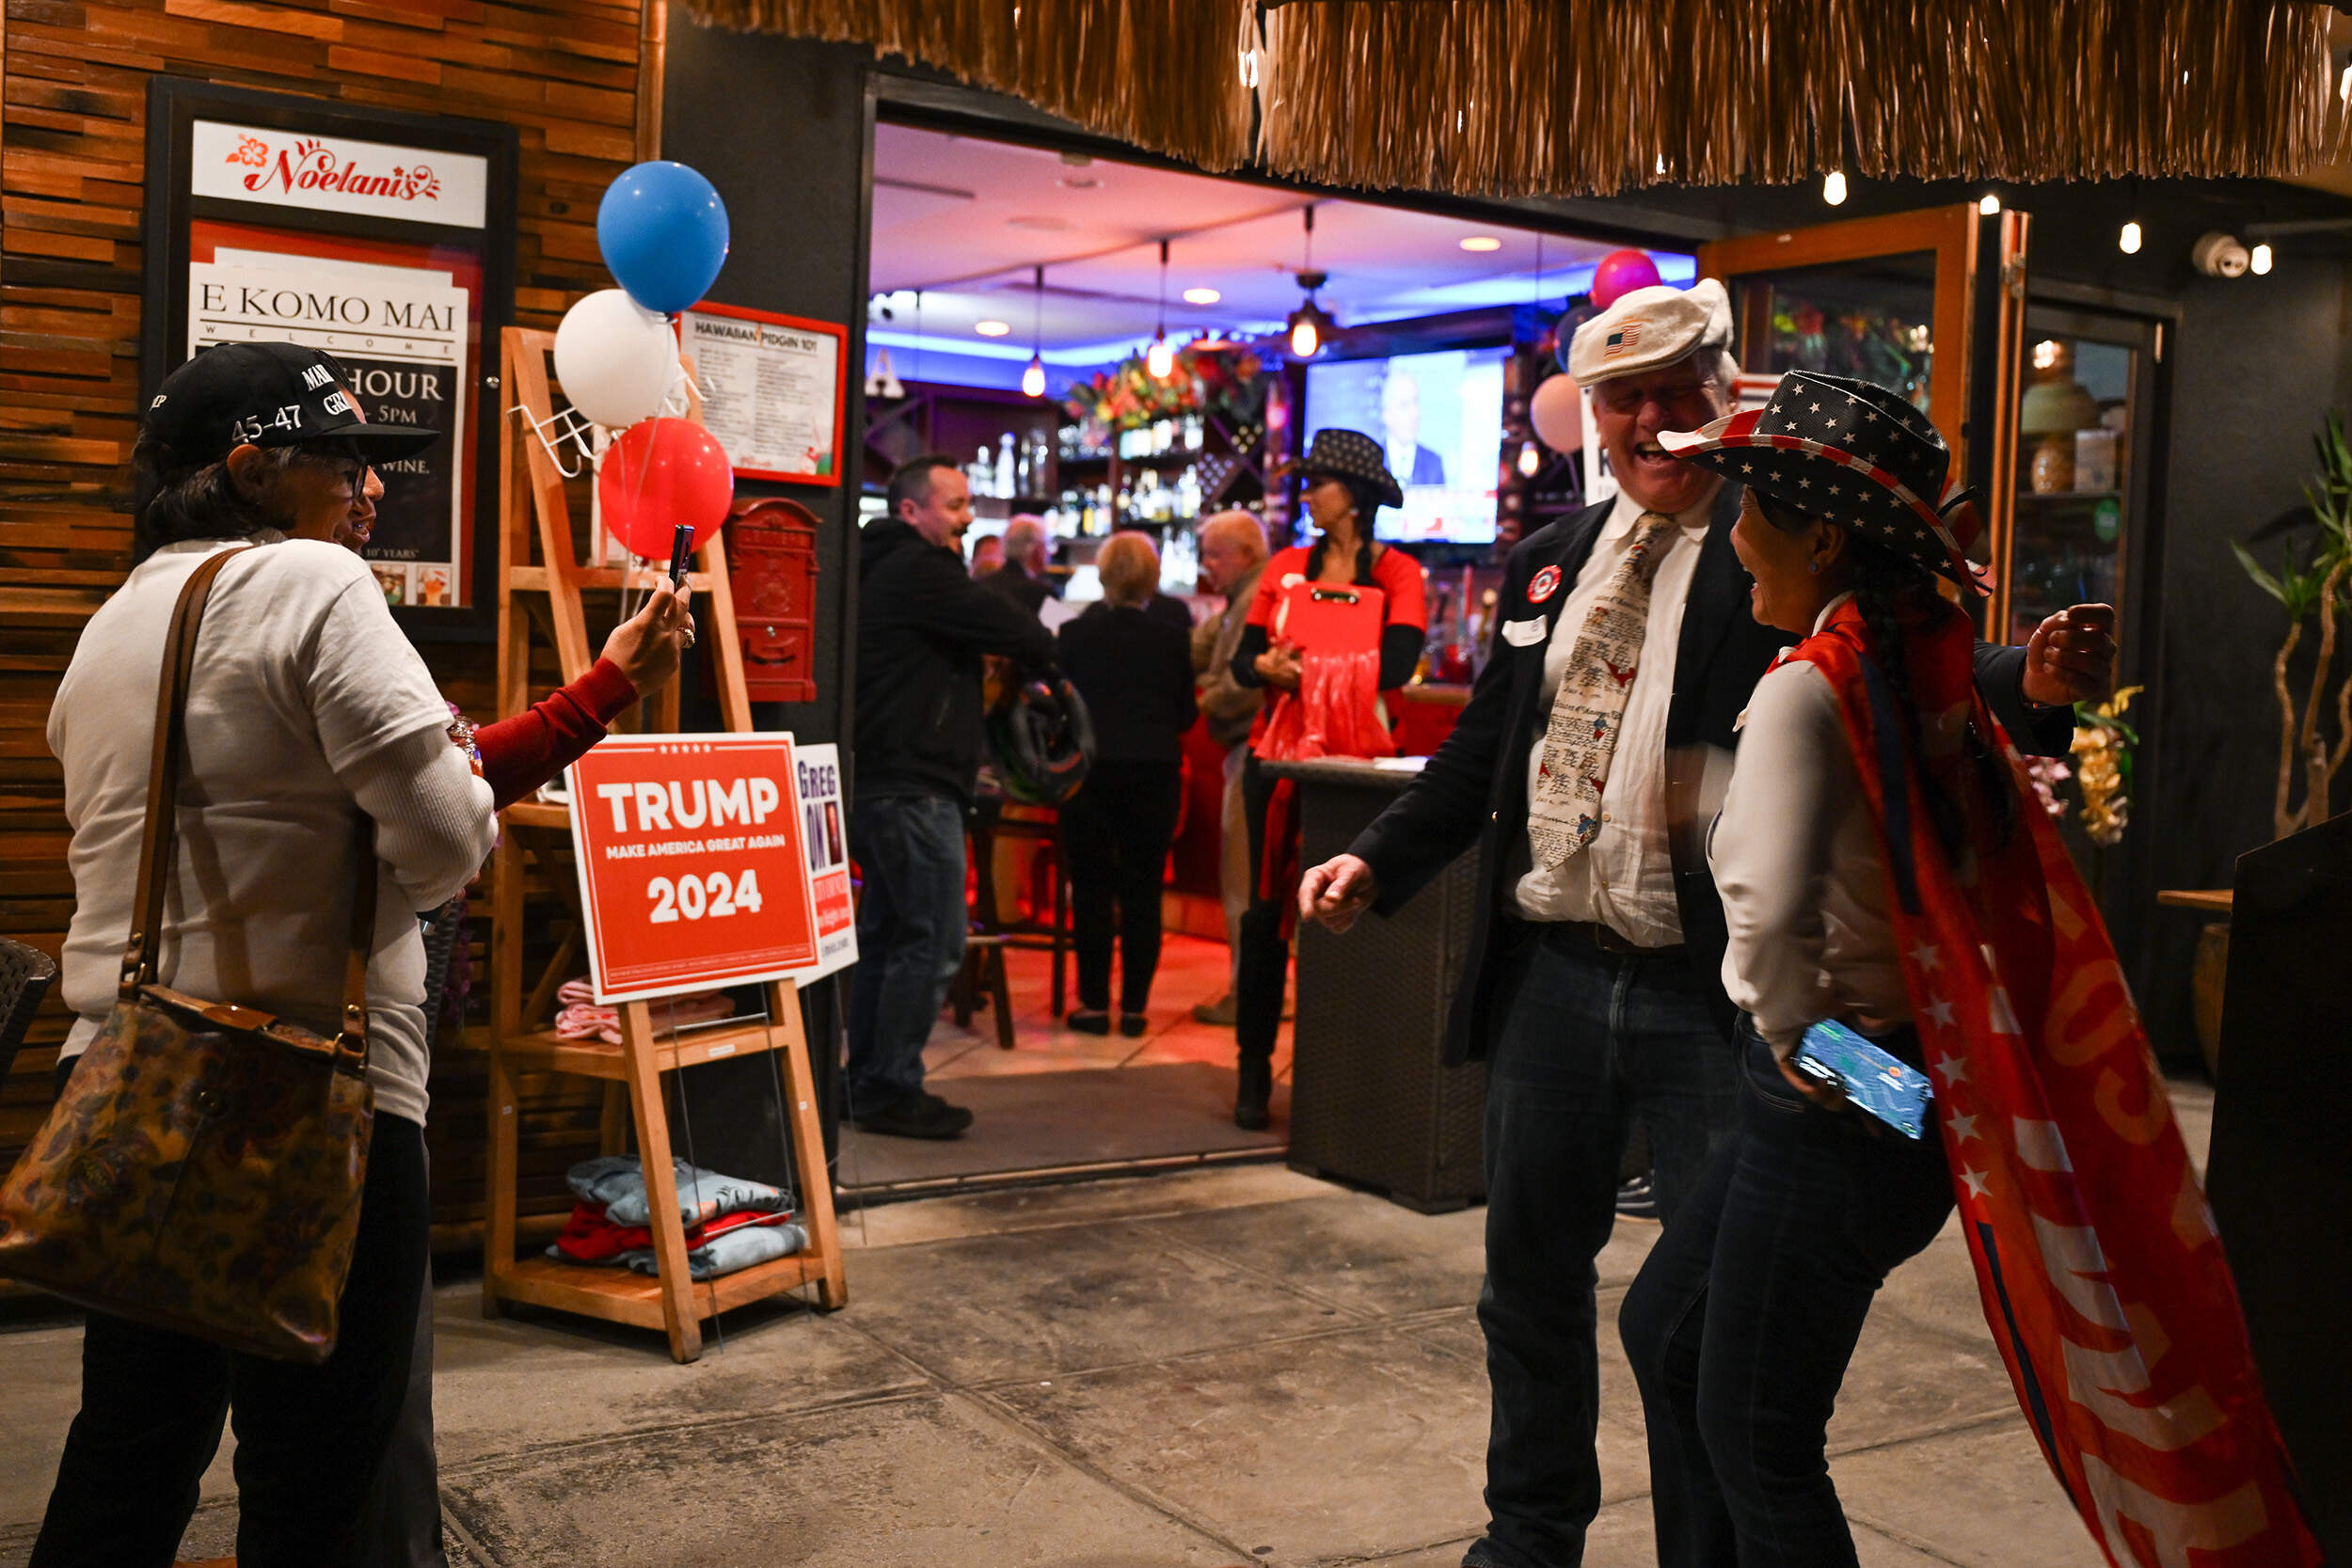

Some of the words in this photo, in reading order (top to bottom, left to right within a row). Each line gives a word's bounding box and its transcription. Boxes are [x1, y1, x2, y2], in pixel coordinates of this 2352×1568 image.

[244, 149, 435, 200] Noelani's
[200, 284, 226, 312] E
[240, 287, 370, 325] KOMO
[383, 300, 455, 332] MAI
[761, 332, 798, 348] PIDGIN
[802, 339, 818, 352] 101
[232, 404, 302, 443] 45-47
[378, 404, 418, 424] 5PM
[798, 760, 836, 799] GREG
[596, 777, 779, 832] TRUMP
[606, 845, 645, 860] MAKE
[647, 840, 705, 856] AMERICA
[706, 837, 746, 852] GREAT
[747, 834, 786, 849] AGAIN
[647, 869, 762, 923] 2024
